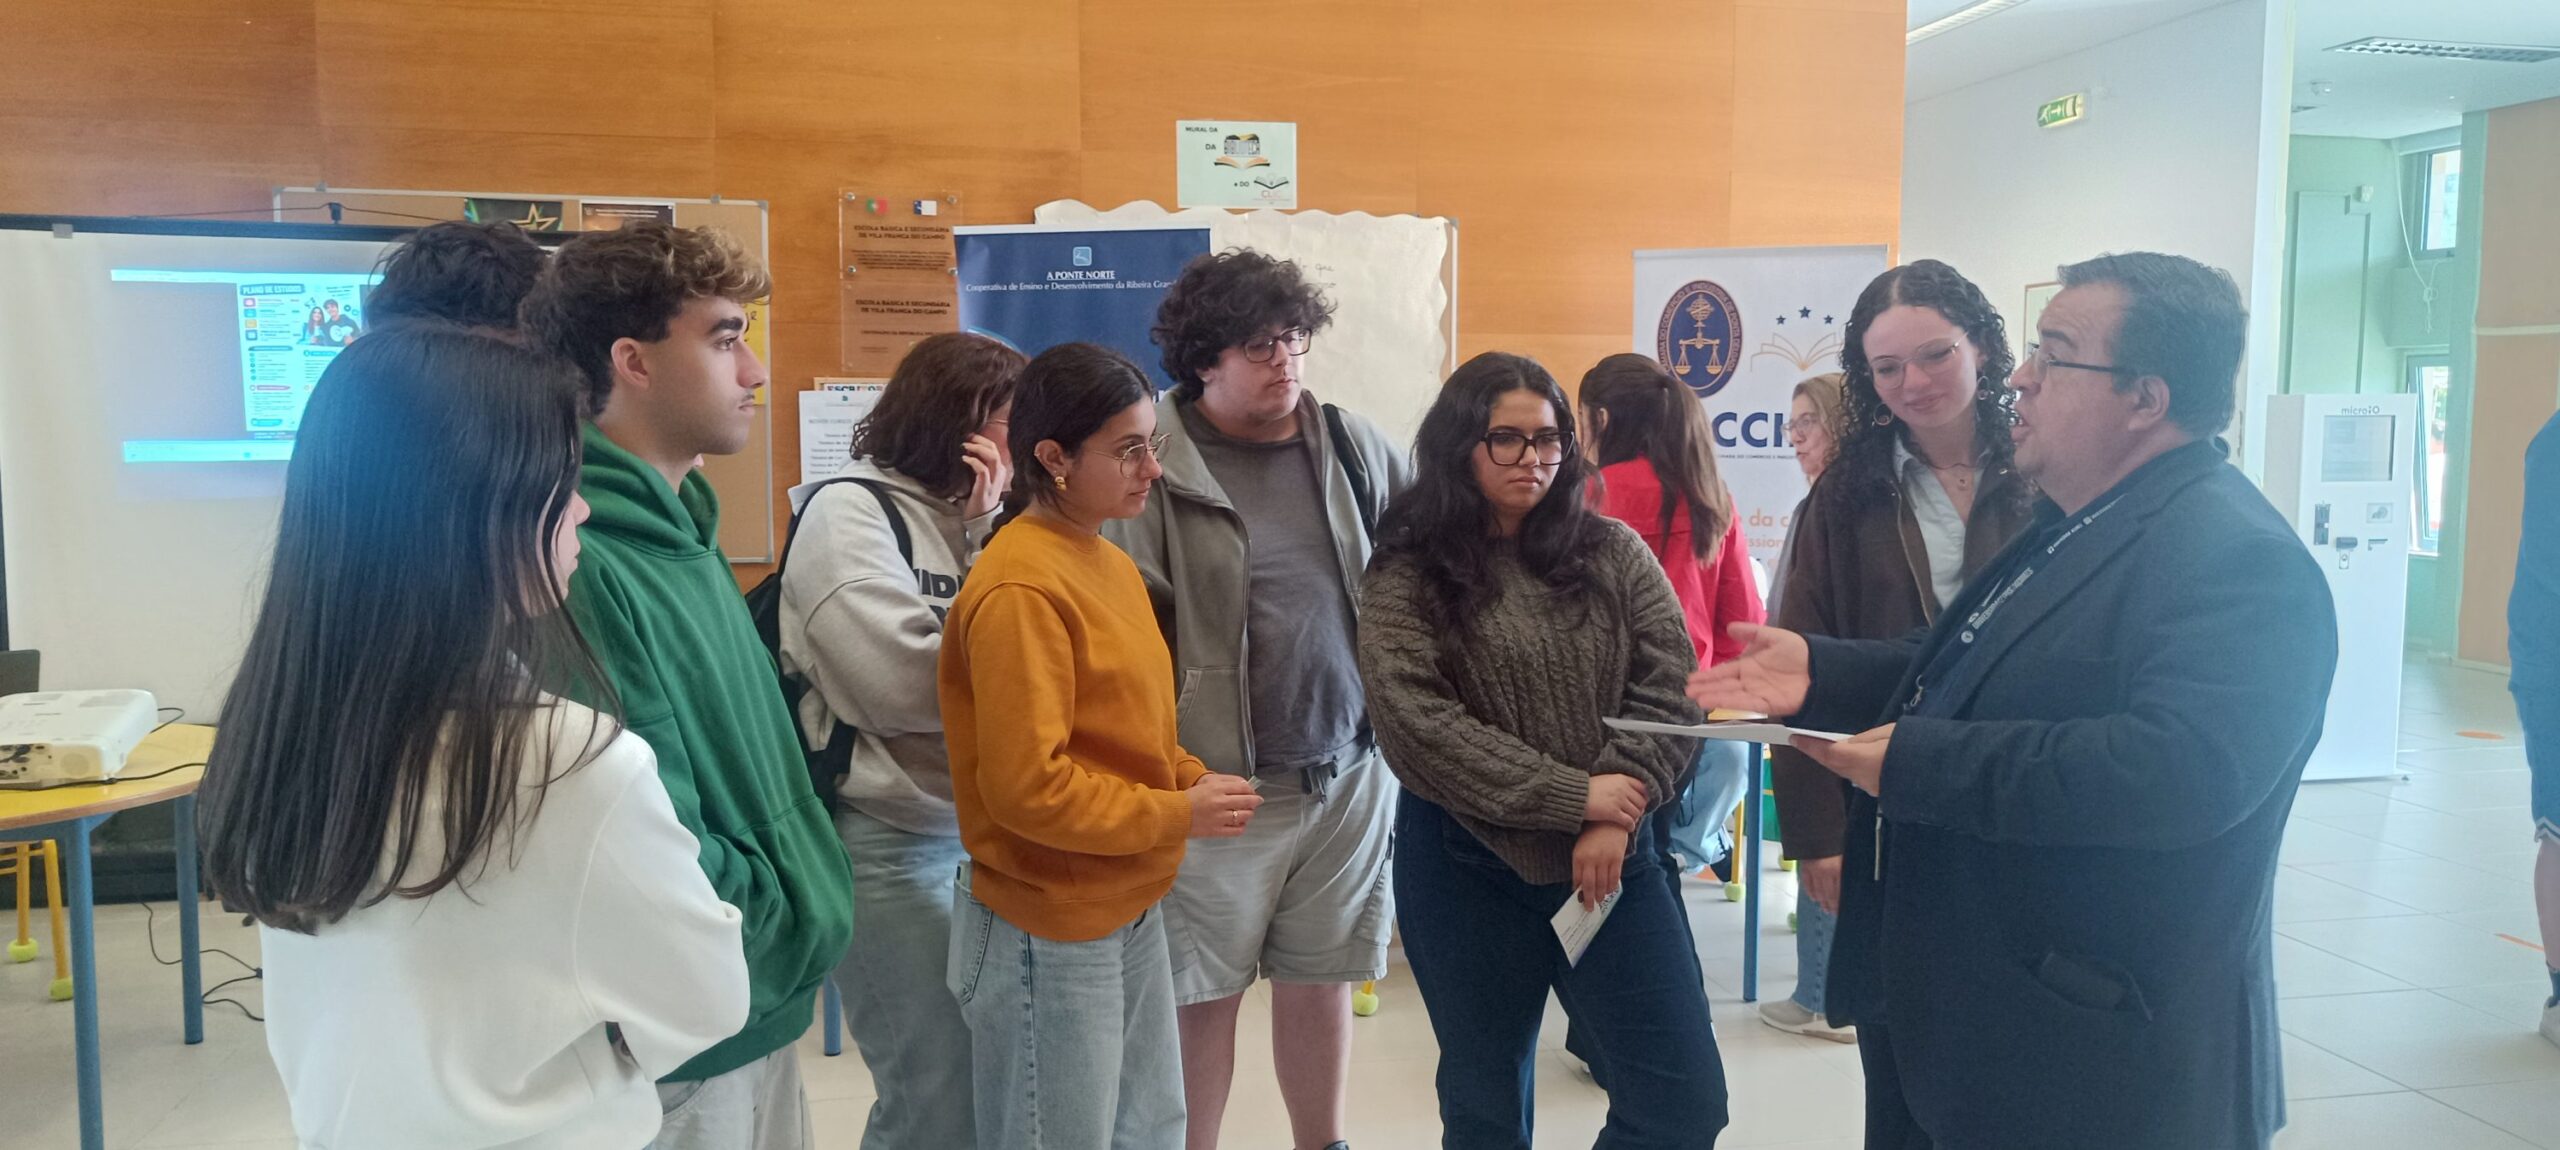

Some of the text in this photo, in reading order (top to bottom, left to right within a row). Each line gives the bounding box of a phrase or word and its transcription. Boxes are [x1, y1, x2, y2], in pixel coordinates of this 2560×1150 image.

[1046, 270, 1115, 280] A PONTE NORTE
[1009, 282, 1018, 290] de
[1019, 282, 1043, 290] Ensino
[1051, 281, 1114, 290] Desenvolvimento
[1115, 281, 1125, 289] da
[1126, 280, 1152, 289] Ribeira
